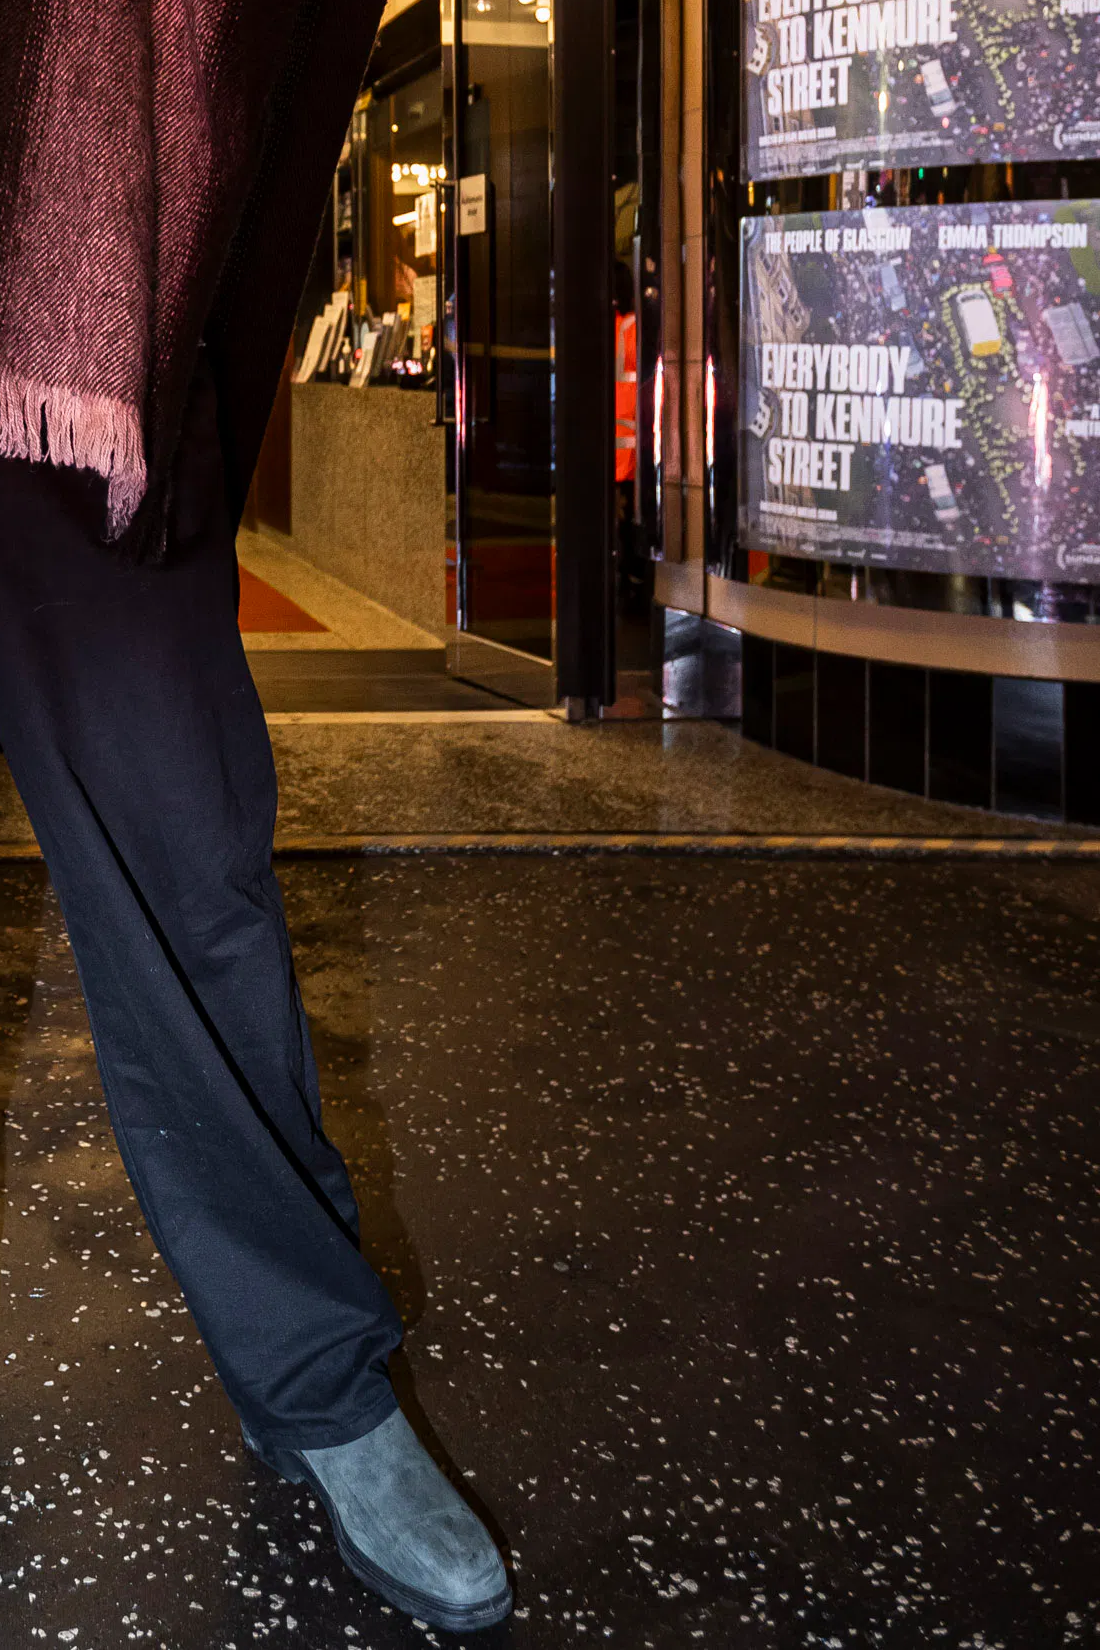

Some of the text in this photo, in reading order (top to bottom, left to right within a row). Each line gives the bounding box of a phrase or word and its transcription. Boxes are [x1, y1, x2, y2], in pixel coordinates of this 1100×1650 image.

[777, 17, 806, 66] TO
[767, 57, 853, 117] STREET
[764, 226, 911, 254] THE PEOPLE OF GLASGOW
[938, 223, 1087, 250] EMMA THOMPSON
[762, 342, 910, 394] EVERYBODY
[780, 391, 965, 449] TO KENMURE
[768, 438, 855, 492] STREET
